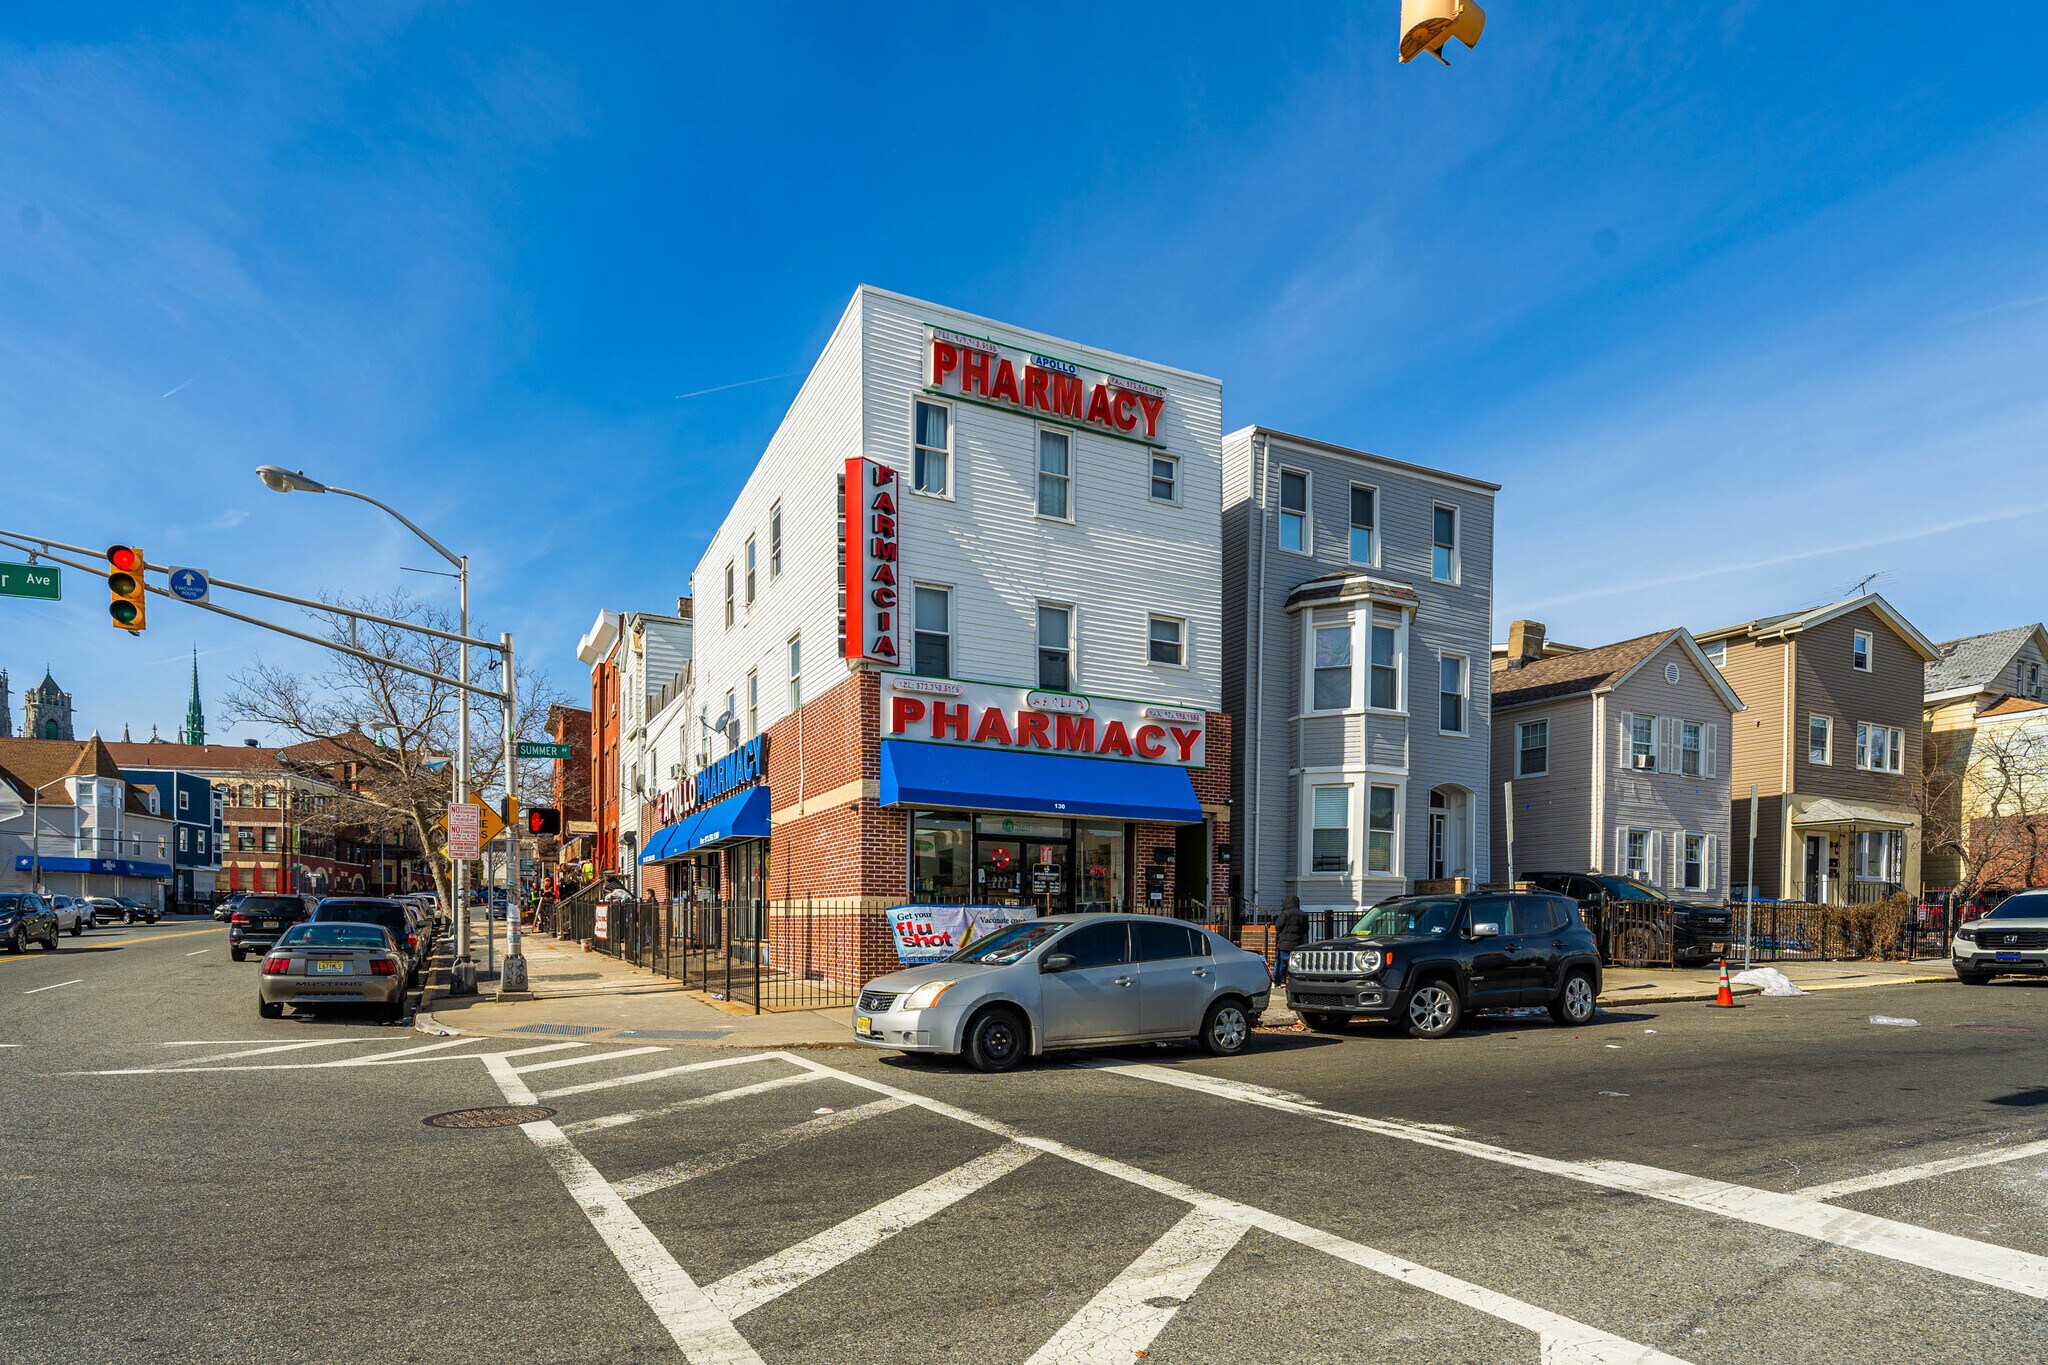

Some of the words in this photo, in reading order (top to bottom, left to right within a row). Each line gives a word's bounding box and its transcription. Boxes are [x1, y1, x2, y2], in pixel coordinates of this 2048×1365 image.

[1035, 356, 1076, 374] APOLLO
[932, 341, 1165, 438] PHARMACY
[872, 465, 897, 657] FARMACIA
[26, 572, 50, 586] Ave
[175, 585, 203, 594] EVACUATION
[891, 696, 1203, 761] PHARMACY
[520, 745, 557, 756] SUMMER
[663, 775, 696, 822] APOLLO
[697, 734, 763, 806] PHARMACY
[451, 806, 460, 814] NO
[897, 912, 912, 921] Get
[914, 911, 932, 921] your
[896, 921, 933, 937] flu
[902, 931, 954, 948] shot
